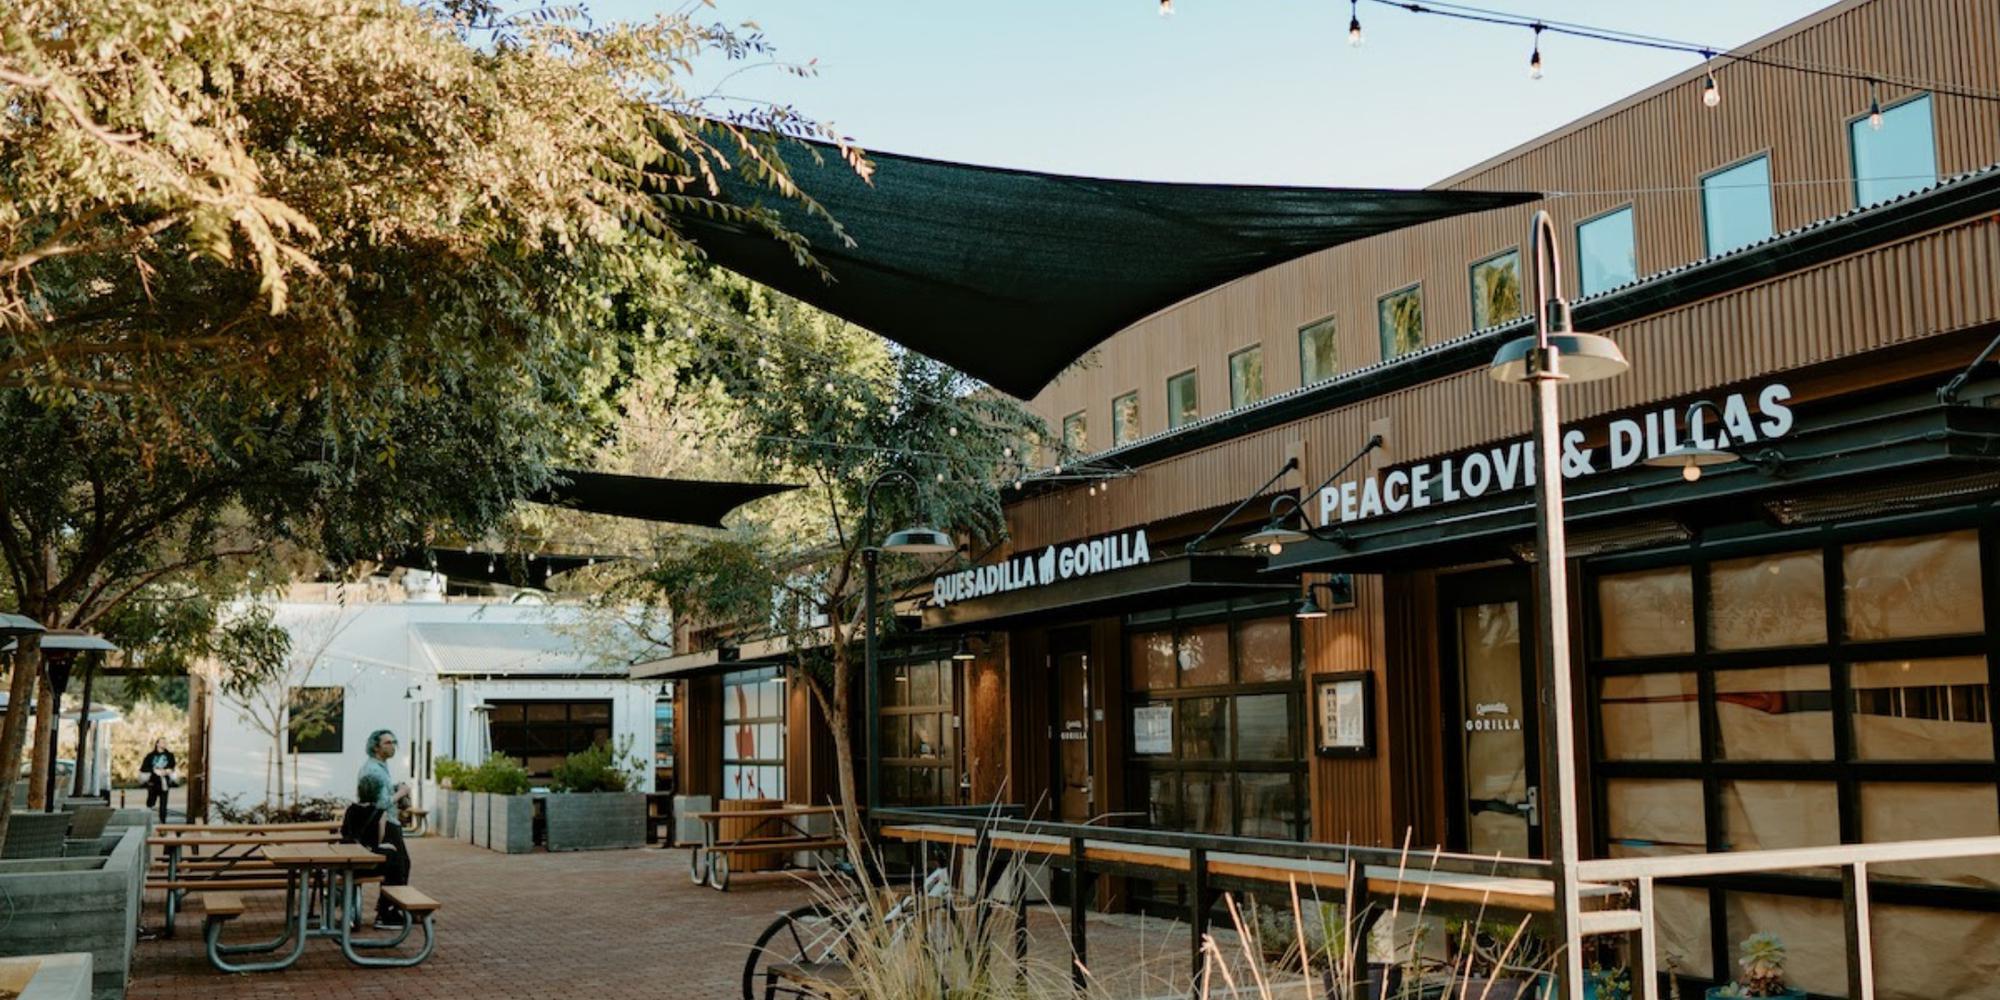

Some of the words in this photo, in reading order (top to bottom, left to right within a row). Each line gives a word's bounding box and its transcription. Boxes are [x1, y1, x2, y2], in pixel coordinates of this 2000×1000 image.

[1320, 464, 1431, 526] PEACE
[1561, 430, 1596, 479] &
[1609, 383, 1794, 470] DILLAS
[933, 556, 1036, 608] QUESADILLA
[1058, 529, 1150, 579] GORILLA
[1466, 719, 1520, 731] GORILLA
